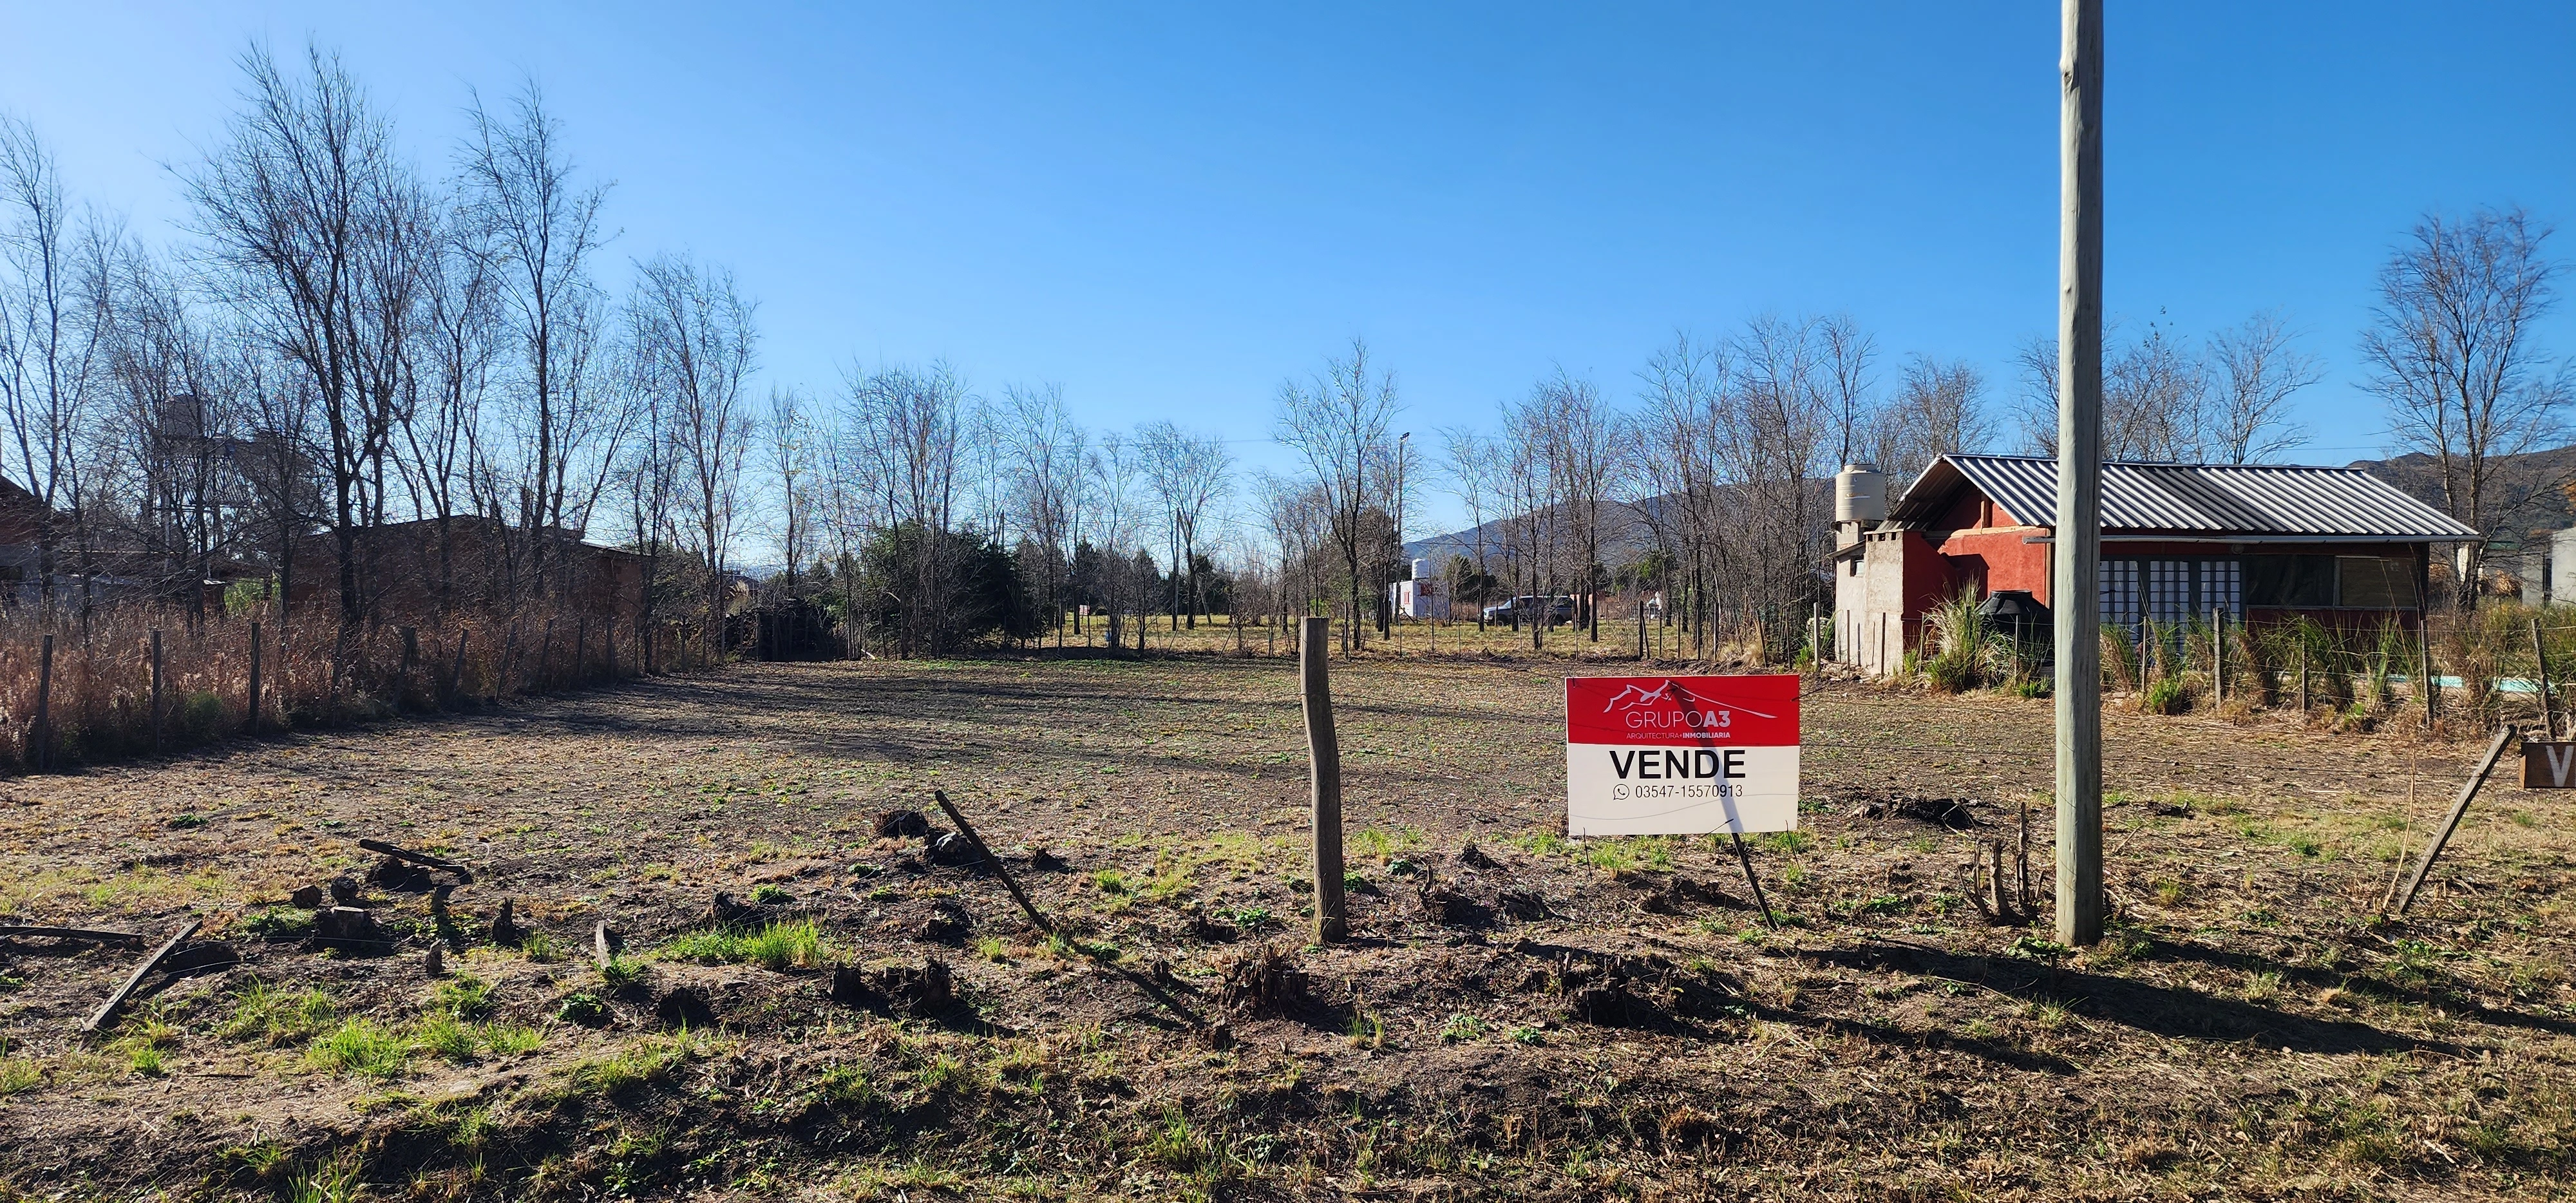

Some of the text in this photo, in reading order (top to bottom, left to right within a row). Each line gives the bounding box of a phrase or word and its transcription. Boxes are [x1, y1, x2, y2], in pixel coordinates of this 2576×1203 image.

[1625, 710, 1731, 728] GRUPOA3
[1609, 750, 1746, 779] VENDE
[2546, 745, 2576, 788] V
[1635, 784, 1743, 798] 03547-15570913
